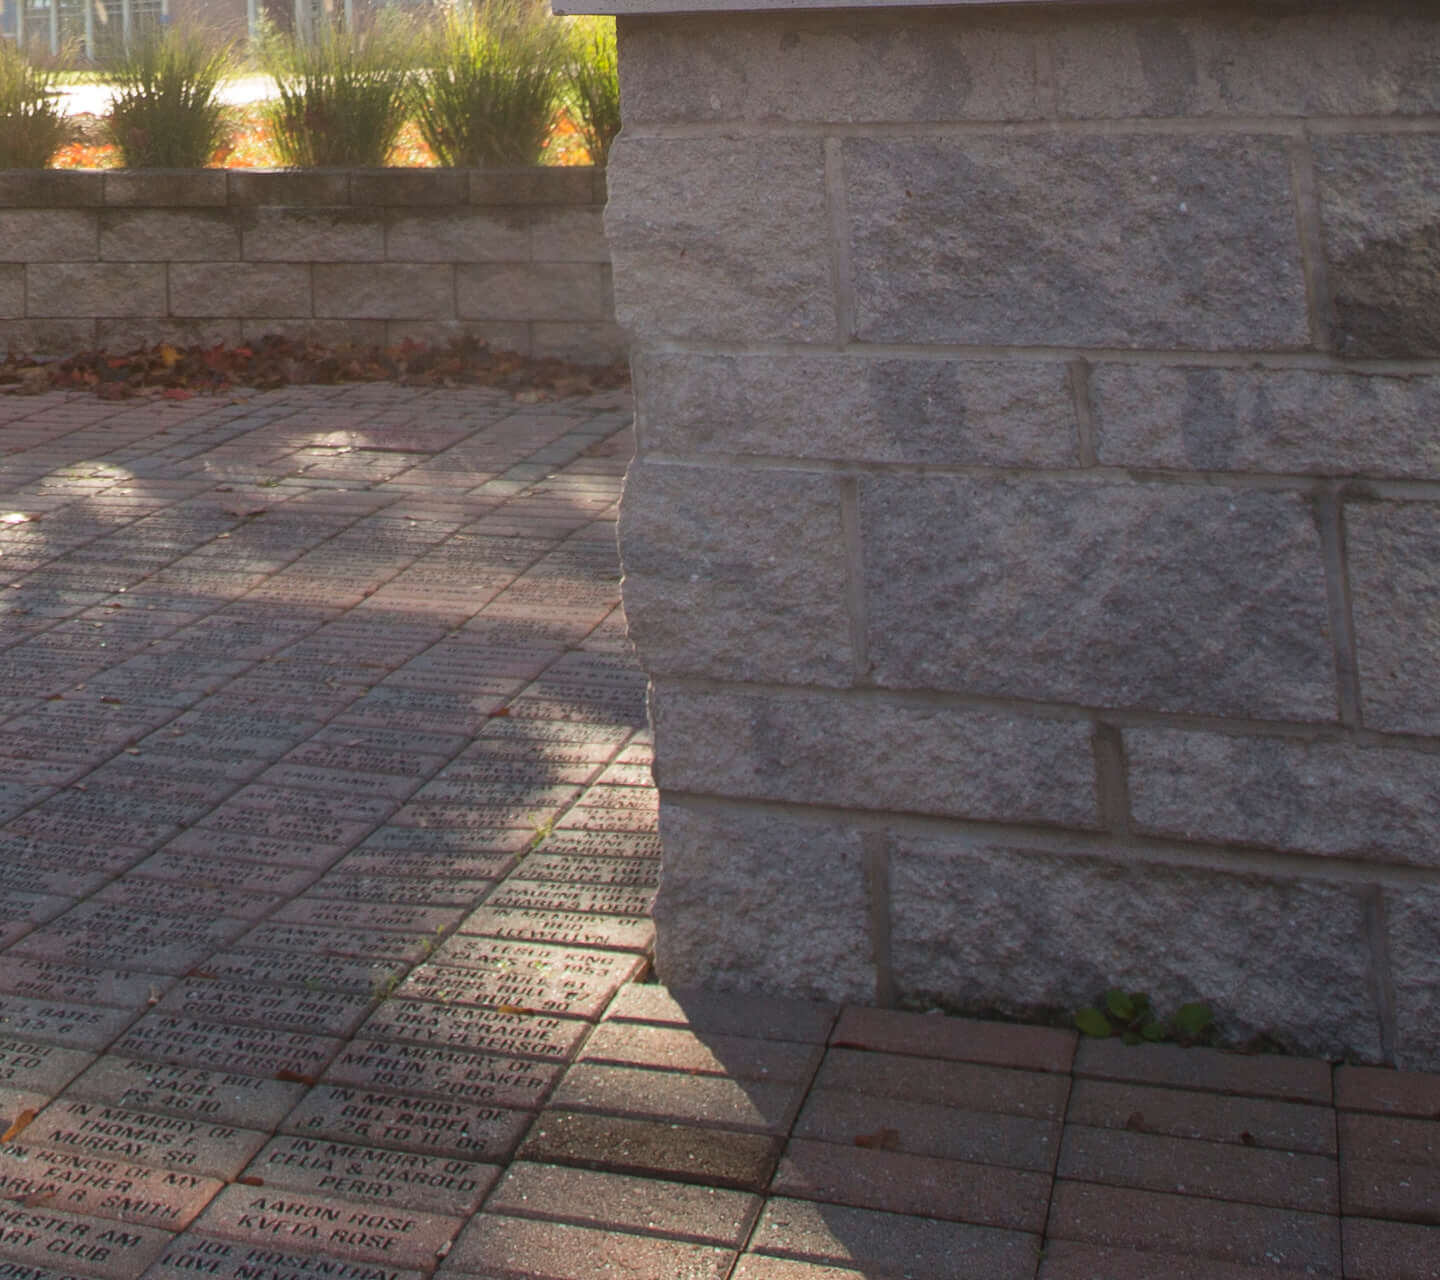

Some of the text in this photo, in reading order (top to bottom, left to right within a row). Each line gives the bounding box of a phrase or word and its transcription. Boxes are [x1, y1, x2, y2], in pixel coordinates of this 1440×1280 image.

[398, 1044, 503, 1067] MEMORY
[328, 1088, 507, 1123] IN MEMORY OF
[67, 1102, 240, 1139] IN MEMORY OF
[79, 1119, 176, 1144] THOMAS
[1, 1144, 204, 1188] IN HONOR OF MY
[289, 1139, 479, 1176] IN MEMORY OF
[42, 1167, 135, 1193] FATHER
[318, 1175, 401, 1197] PERRY
[345, 1161, 365, 1175] &
[375, 1166, 477, 1192] HAROLD
[99, 1195, 182, 1220] SMITH
[249, 1197, 418, 1233] AARON ROSE
[45, 1238, 112, 1262] CLUB
[328, 1228, 400, 1251] ROSE
